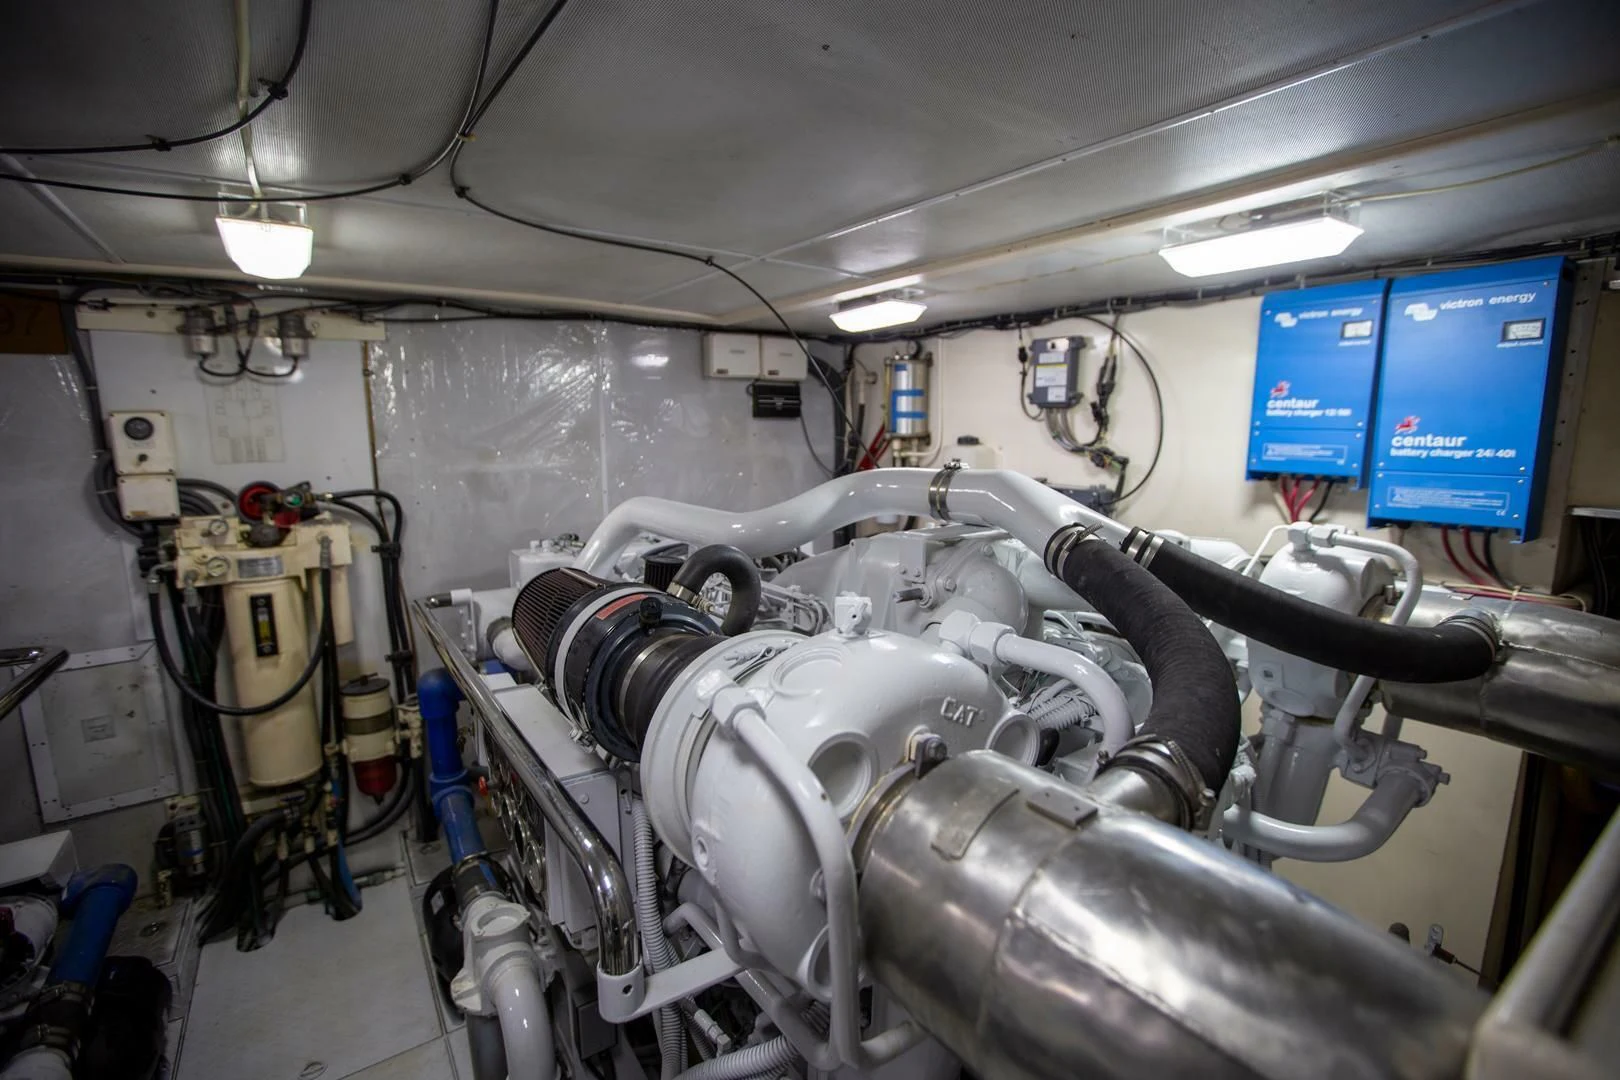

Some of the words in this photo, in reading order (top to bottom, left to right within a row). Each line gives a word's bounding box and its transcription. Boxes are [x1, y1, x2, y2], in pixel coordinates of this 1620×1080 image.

[1440, 298, 1484, 310] victron
[1488, 292, 1537, 304] energy
[1266, 397, 1320, 409] centaur
[1391, 433, 1468, 447] centaur
[1389, 447, 1429, 459] battery
[1429, 448, 1475, 459] charger
[940, 695, 979, 727] CAT
